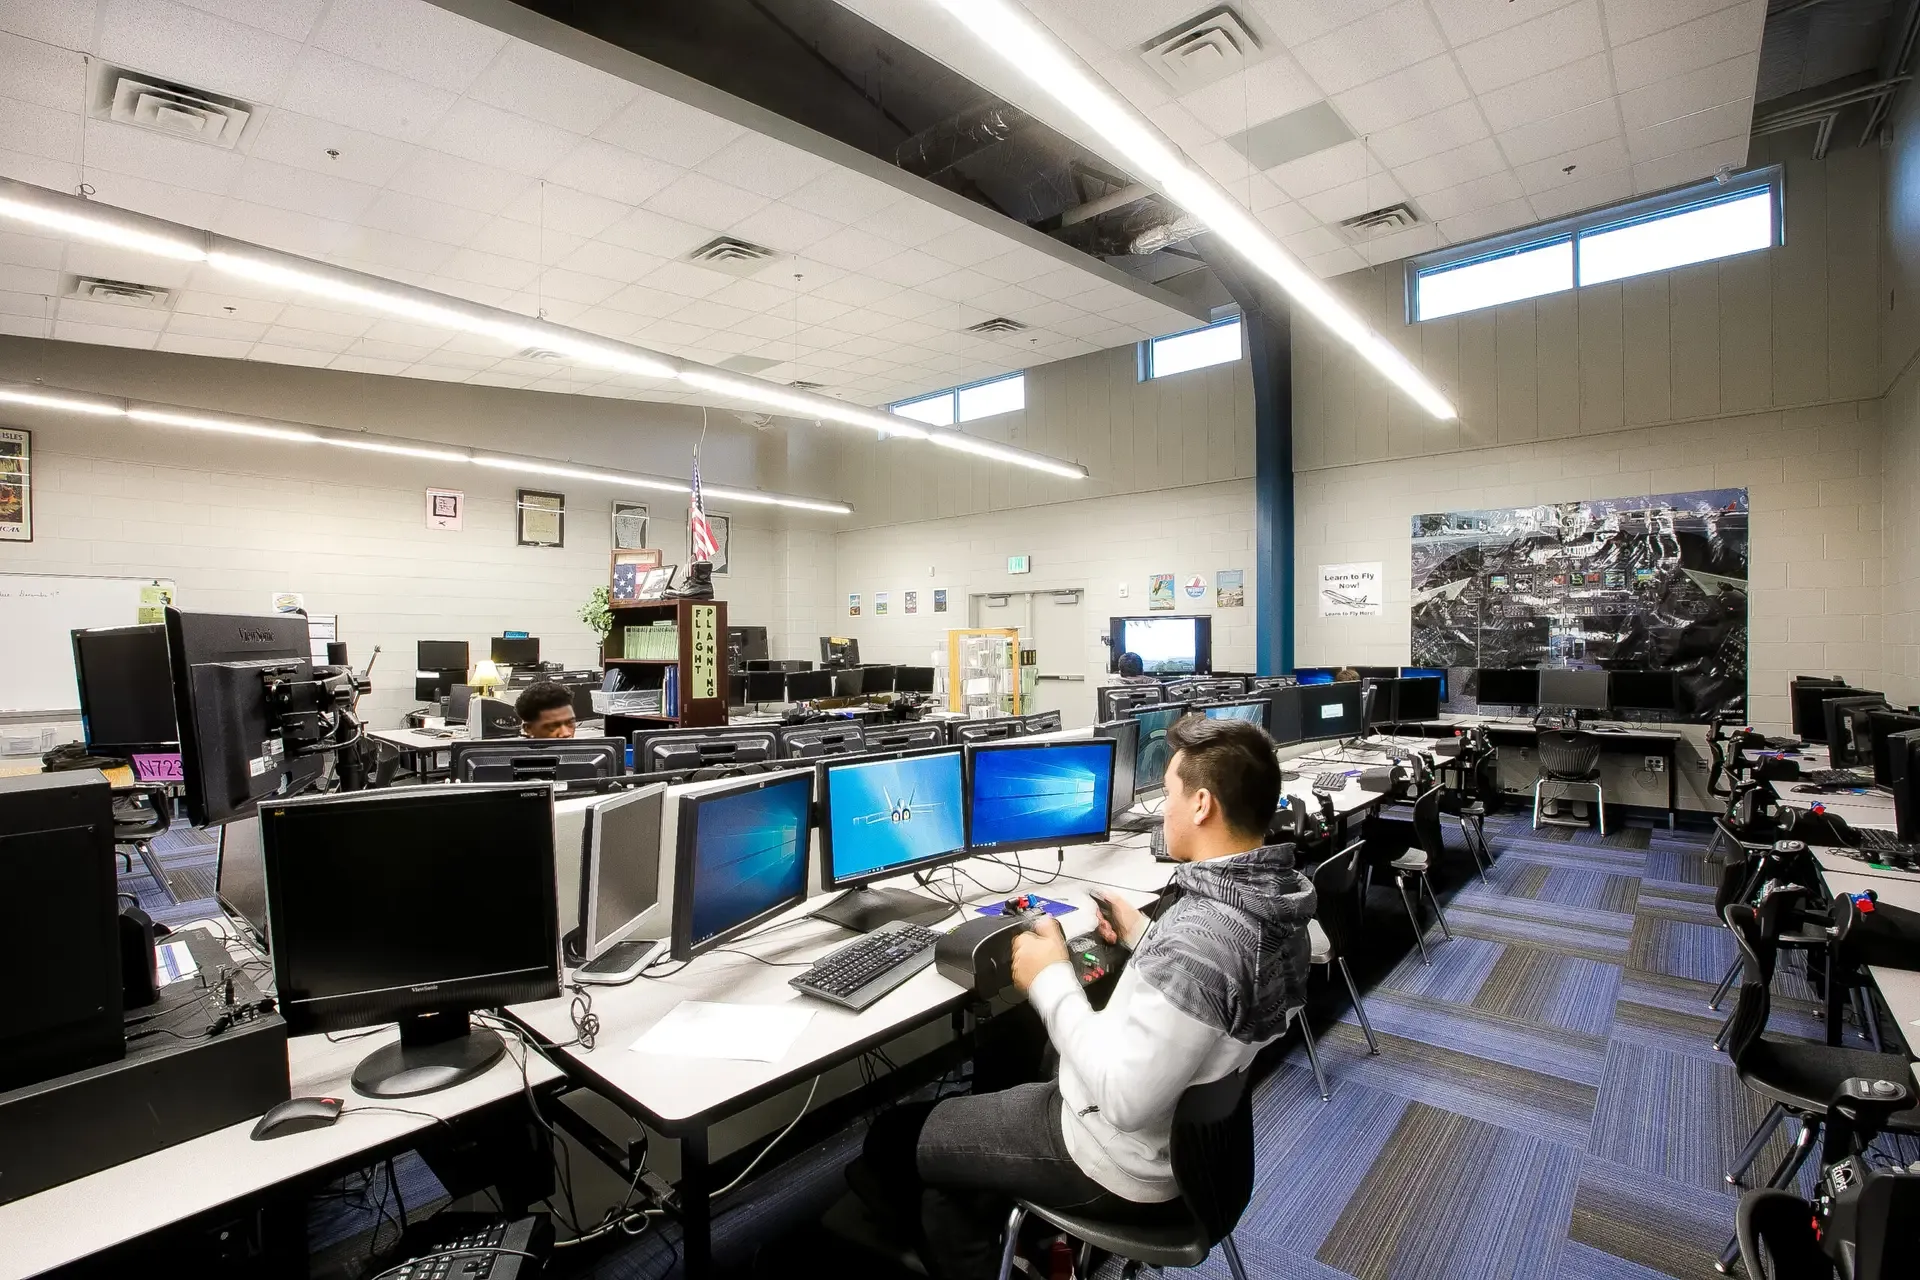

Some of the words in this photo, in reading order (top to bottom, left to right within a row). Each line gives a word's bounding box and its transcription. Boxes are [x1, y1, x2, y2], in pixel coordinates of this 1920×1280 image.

[2, 432, 23, 440] ISLES
[1361, 572, 1374, 580] Fly
[238, 627, 275, 643] ViewSonic
[695, 609, 703, 674] FLIGHT
[706, 608, 714, 697] PLANNING
